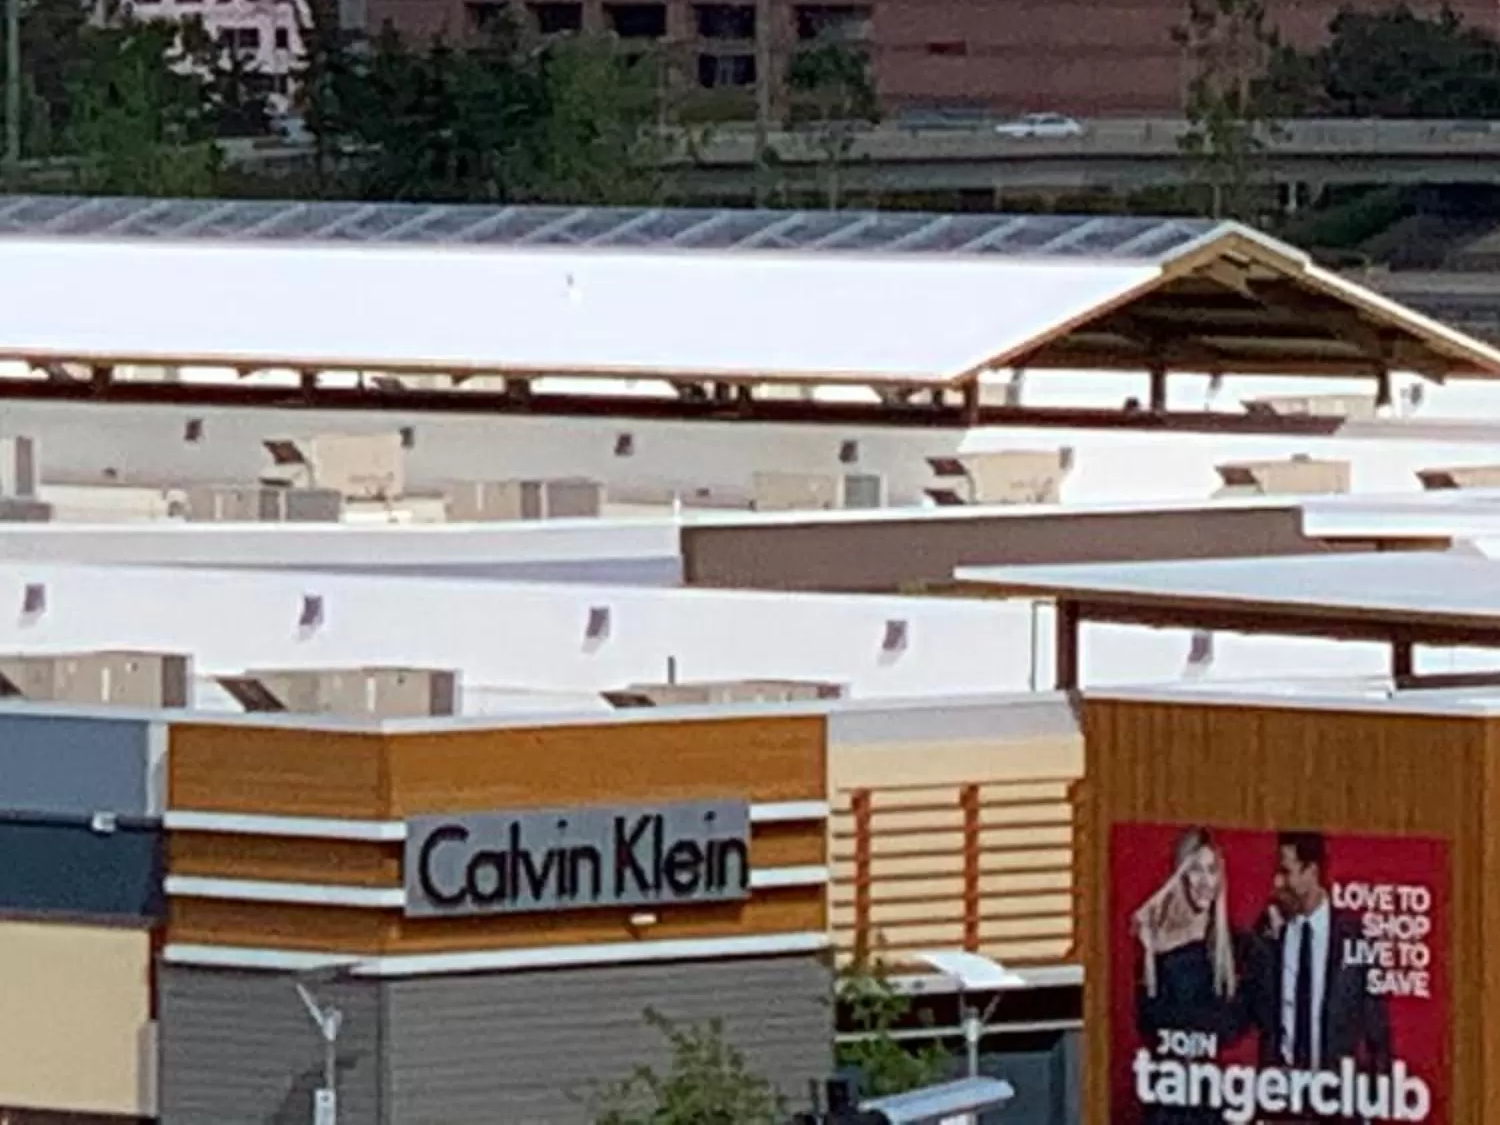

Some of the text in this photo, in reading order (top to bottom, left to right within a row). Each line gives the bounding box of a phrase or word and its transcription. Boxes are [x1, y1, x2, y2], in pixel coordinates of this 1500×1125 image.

[418, 810, 748, 907] Calvin Klein
[1332, 882, 1431, 912] LOVE TO
[1362, 912, 1431, 940] SHOP
[1344, 938, 1431, 968] LIVE TO
[1366, 971, 1431, 998] SAVE
[1157, 1029, 1217, 1059] JOIN
[1132, 1049, 1430, 1123] tangerclub
